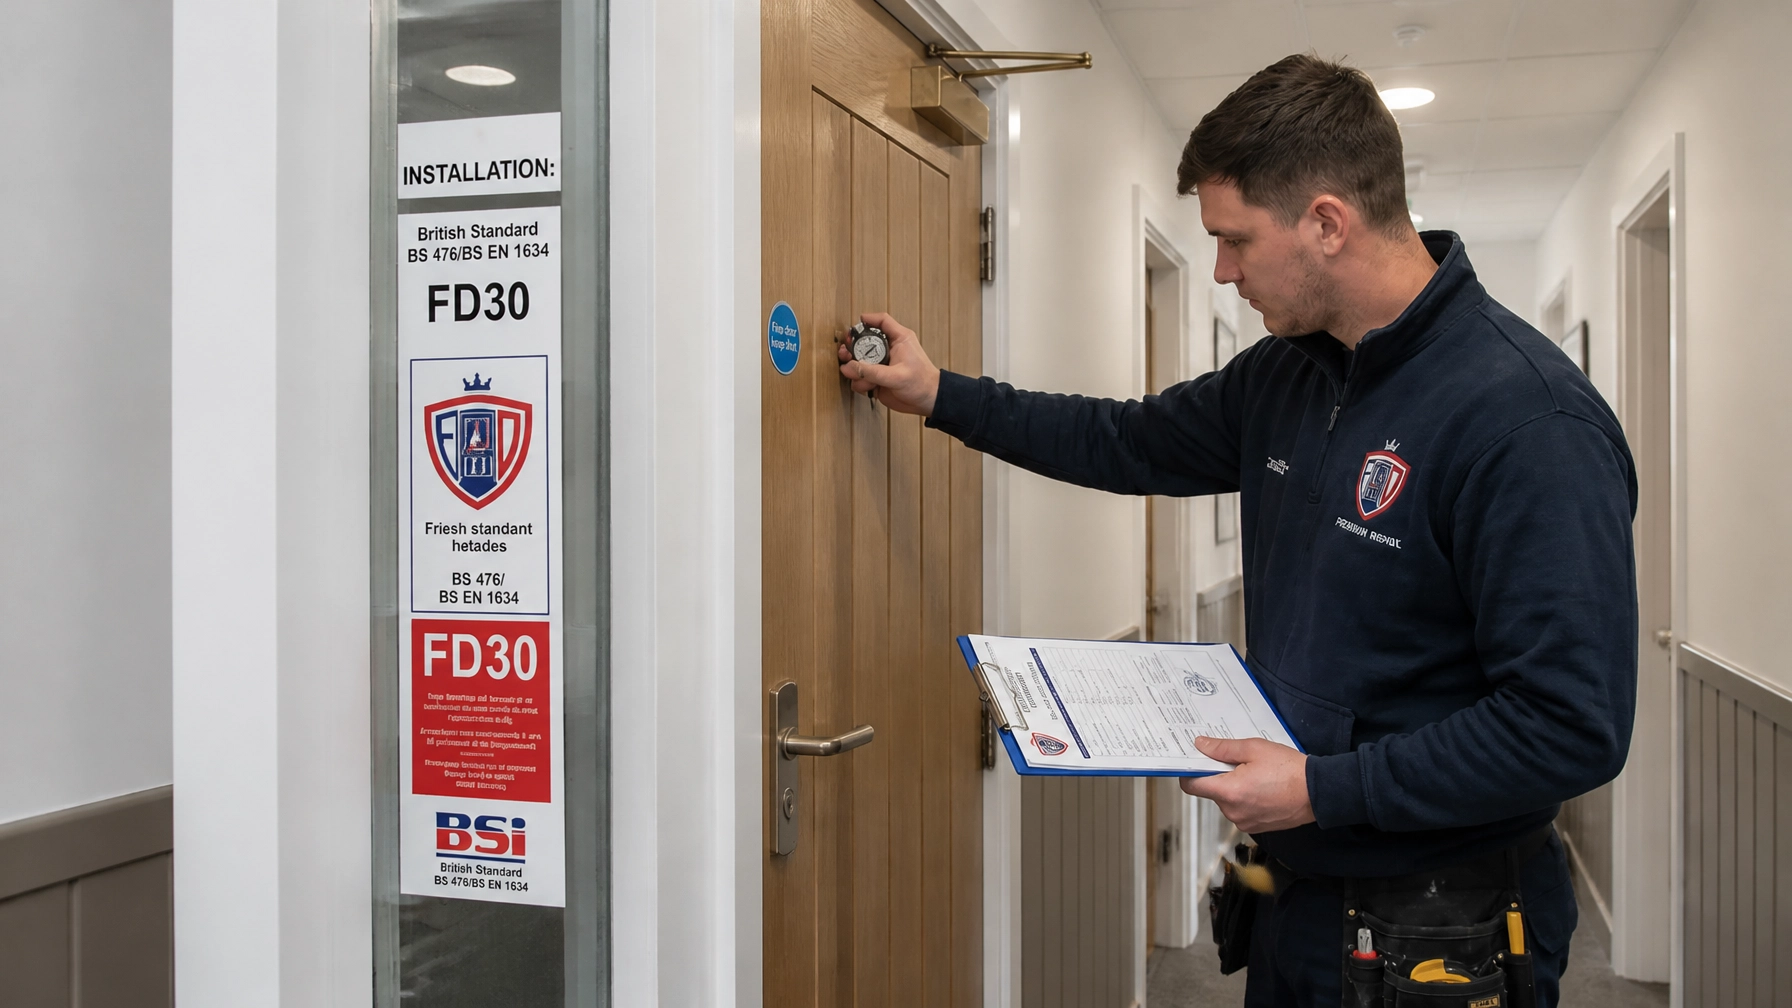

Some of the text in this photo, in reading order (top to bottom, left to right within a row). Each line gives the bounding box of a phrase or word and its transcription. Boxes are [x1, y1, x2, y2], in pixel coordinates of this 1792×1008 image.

[403, 158, 555, 185] INSTALLATION:
[418, 221, 538, 241] British Standard
[408, 242, 549, 263] BS 476/BS EN 1634
[428, 281, 529, 323] FD30
[425, 522, 533, 536] Friesh standant
[452, 539, 507, 553] hetades
[452, 572, 505, 587] BS 476/
[439, 590, 519, 605] BS EN 1634
[424, 632, 538, 682] FD30
[440, 862, 522, 878] British Standard
[434, 876, 529, 892] BS 476/BS EN 1634
